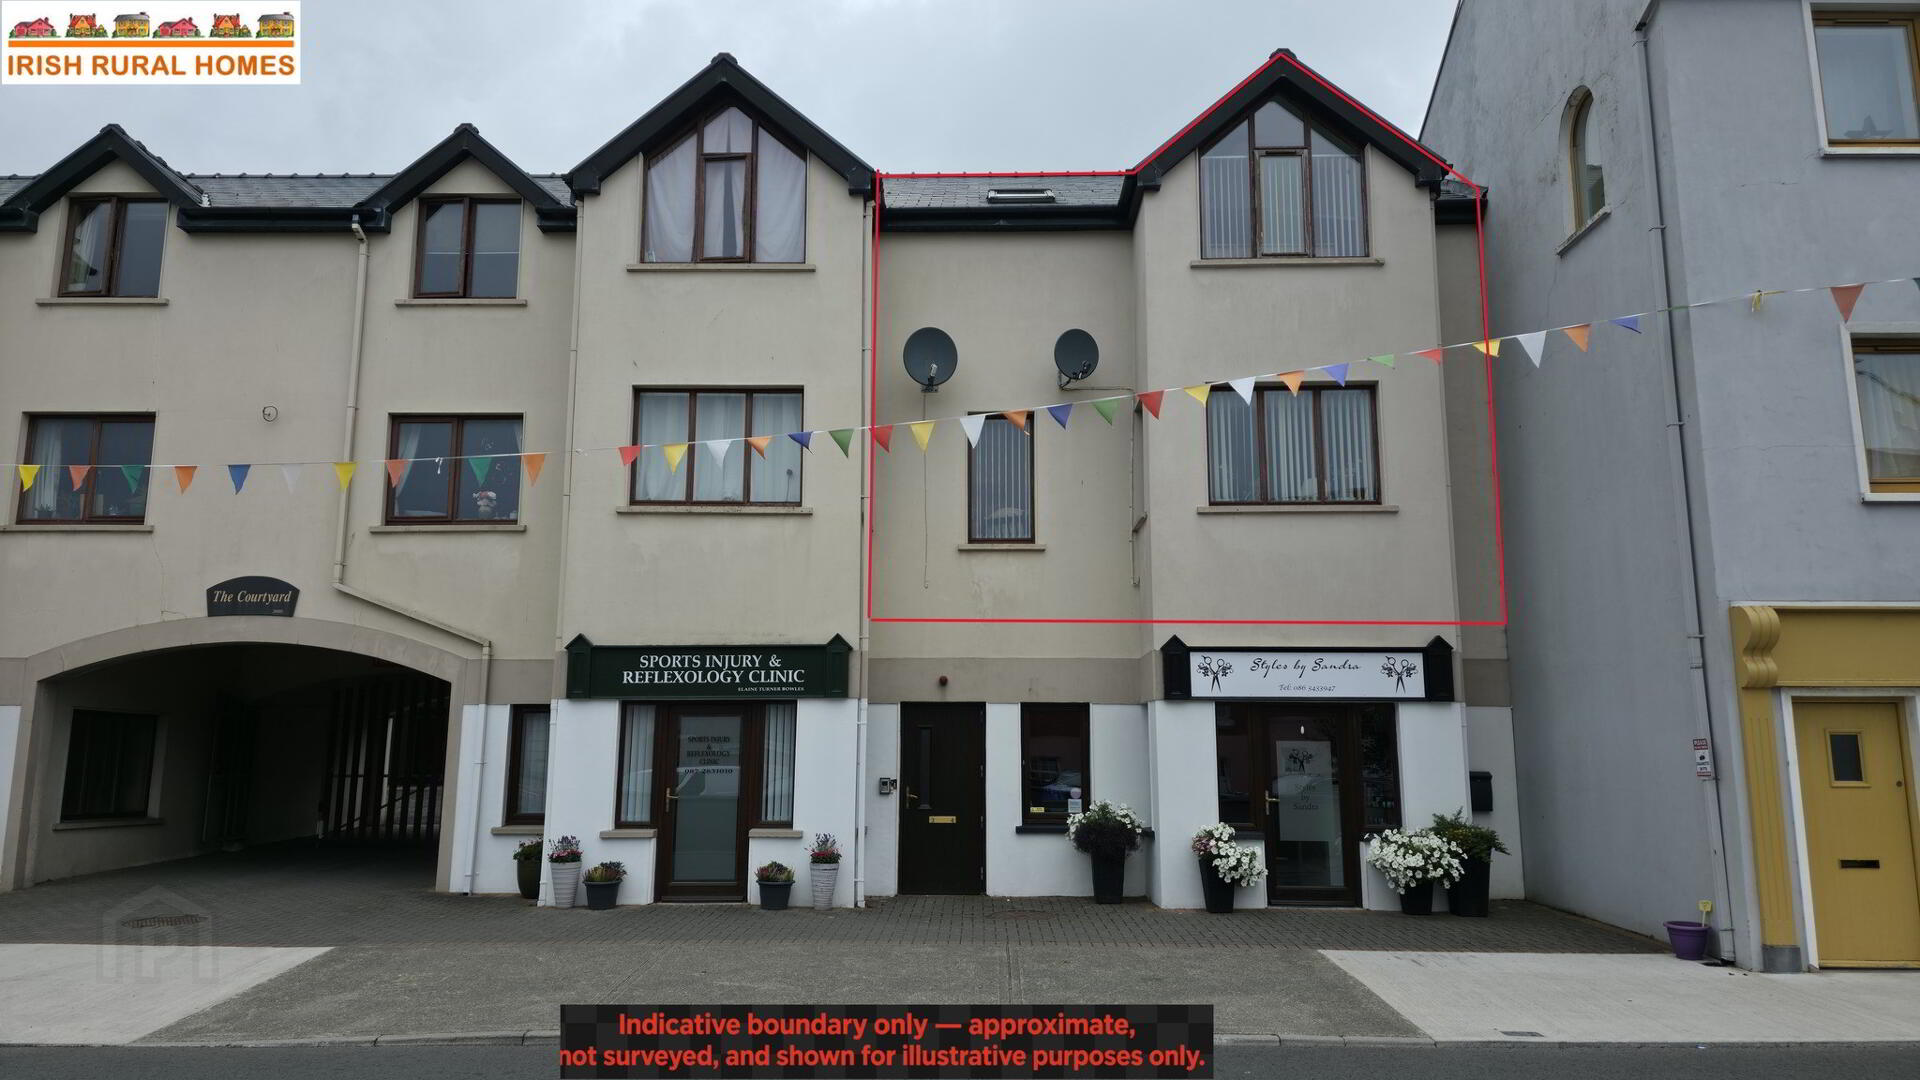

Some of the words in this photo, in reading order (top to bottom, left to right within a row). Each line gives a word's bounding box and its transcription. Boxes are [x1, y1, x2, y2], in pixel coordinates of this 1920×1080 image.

[213, 590, 233, 602] The
[237, 590, 292, 605] Courtyard
[639, 654, 701, 668] SPORTS
[705, 654, 763, 670] INJURY
[769, 654, 782, 667] &
[1250, 658, 1287, 678] Styles
[1293, 660, 1307, 678] by
[1312, 658, 1360, 672] Sandra
[622, 670, 744, 684] REFLEXOLOGY
[748, 669, 805, 683] CLINIC
